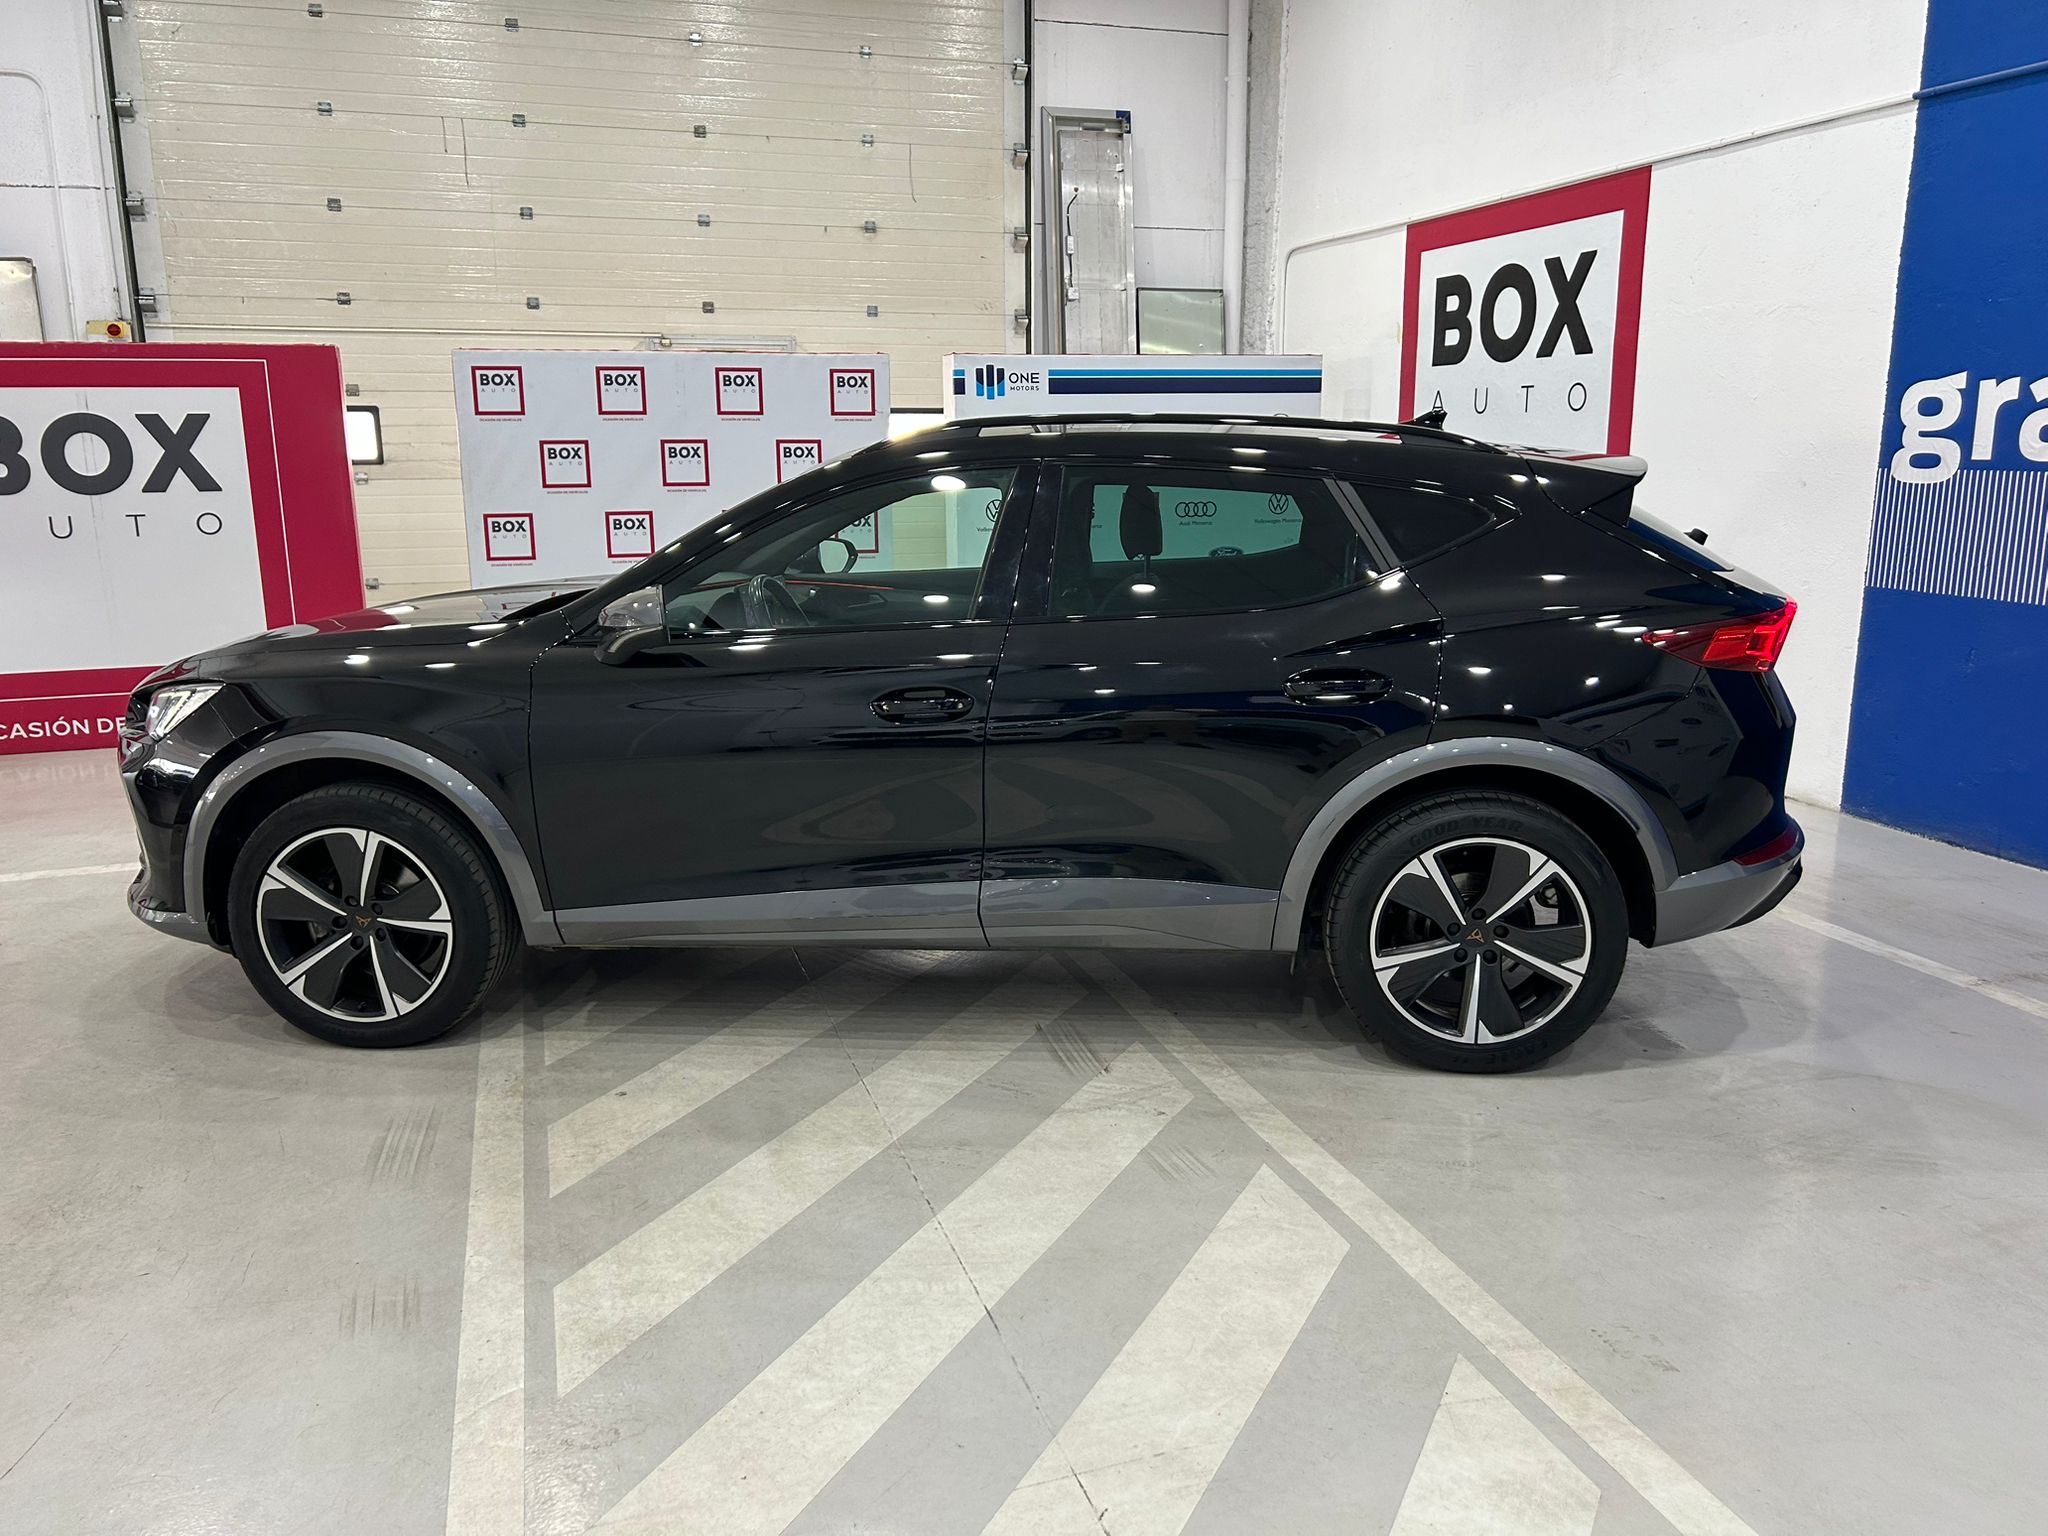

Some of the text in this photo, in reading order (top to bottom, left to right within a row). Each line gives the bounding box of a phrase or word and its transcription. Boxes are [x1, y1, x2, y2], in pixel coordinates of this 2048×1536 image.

[1432, 250, 1598, 367] BOX
[479, 373, 515, 386] BOX
[603, 373, 639, 386] BOX
[722, 374, 756, 387] BOX
[836, 376, 868, 388] BOX
[1008, 372, 1040, 384] ONE
[1431, 381, 1588, 415] AUTO
[546, 447, 582, 459] BOX
[667, 446, 703, 458] BOX
[782, 446, 816, 458] BOX
[491, 520, 527, 532] BOX
[611, 518, 647, 530] BOX
